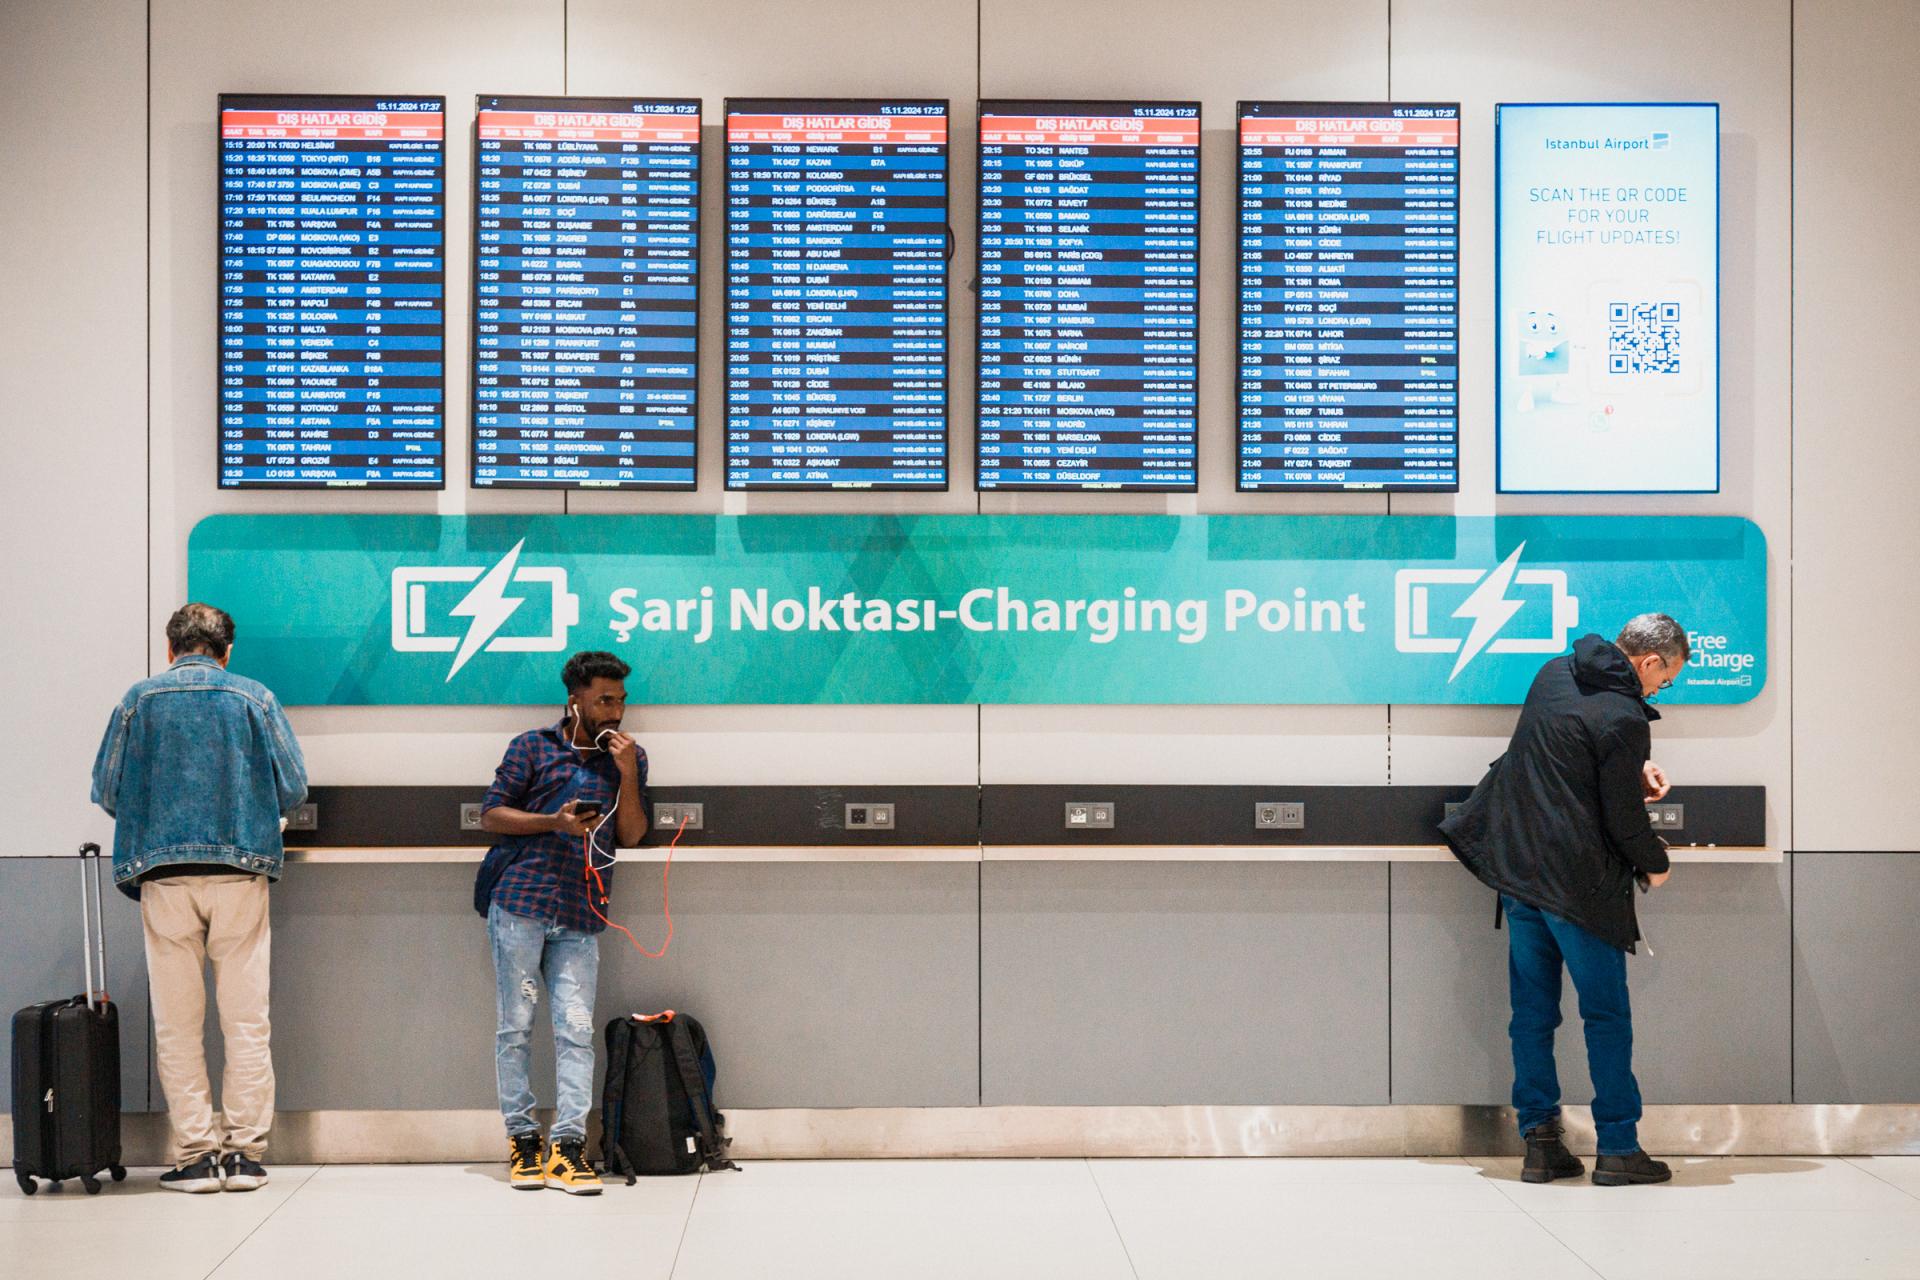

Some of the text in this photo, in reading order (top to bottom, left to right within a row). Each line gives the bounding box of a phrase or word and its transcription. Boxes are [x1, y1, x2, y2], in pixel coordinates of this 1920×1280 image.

[376, 103, 441, 112] 15.11.2024 17:37
[633, 105, 697, 114] 15.11.2024 17:37
[1133, 108, 1197, 117] 15.11.2024 17:37
[1393, 109, 1456, 117] 15.11.2024 17:37
[278, 113, 387, 126] DIŞ HATLAR GİDİŞ
[535, 115, 643, 127] DIŞ HATLAR GİDİŞ
[783, 117, 891, 130] DIŞ HATLAR GİDİŞ
[1036, 119, 1144, 132] DIŞ HATLAR GİDİŞ
[1296, 120, 1403, 132] DIŞ HATLAR GİDİŞ
[1546, 138, 1649, 150] Istanbul Airport
[1529, 188, 1687, 201] SCAN THE QR CODE
[1568, 209, 1649, 222] FOR YOUR
[1536, 231, 1681, 244] FLIGHT UPDATES!
[608, 586, 1366, 644] Şarj Noktası-Charging Point
[1687, 632, 1727, 648] Free
[1687, 649, 1754, 672] Charge
